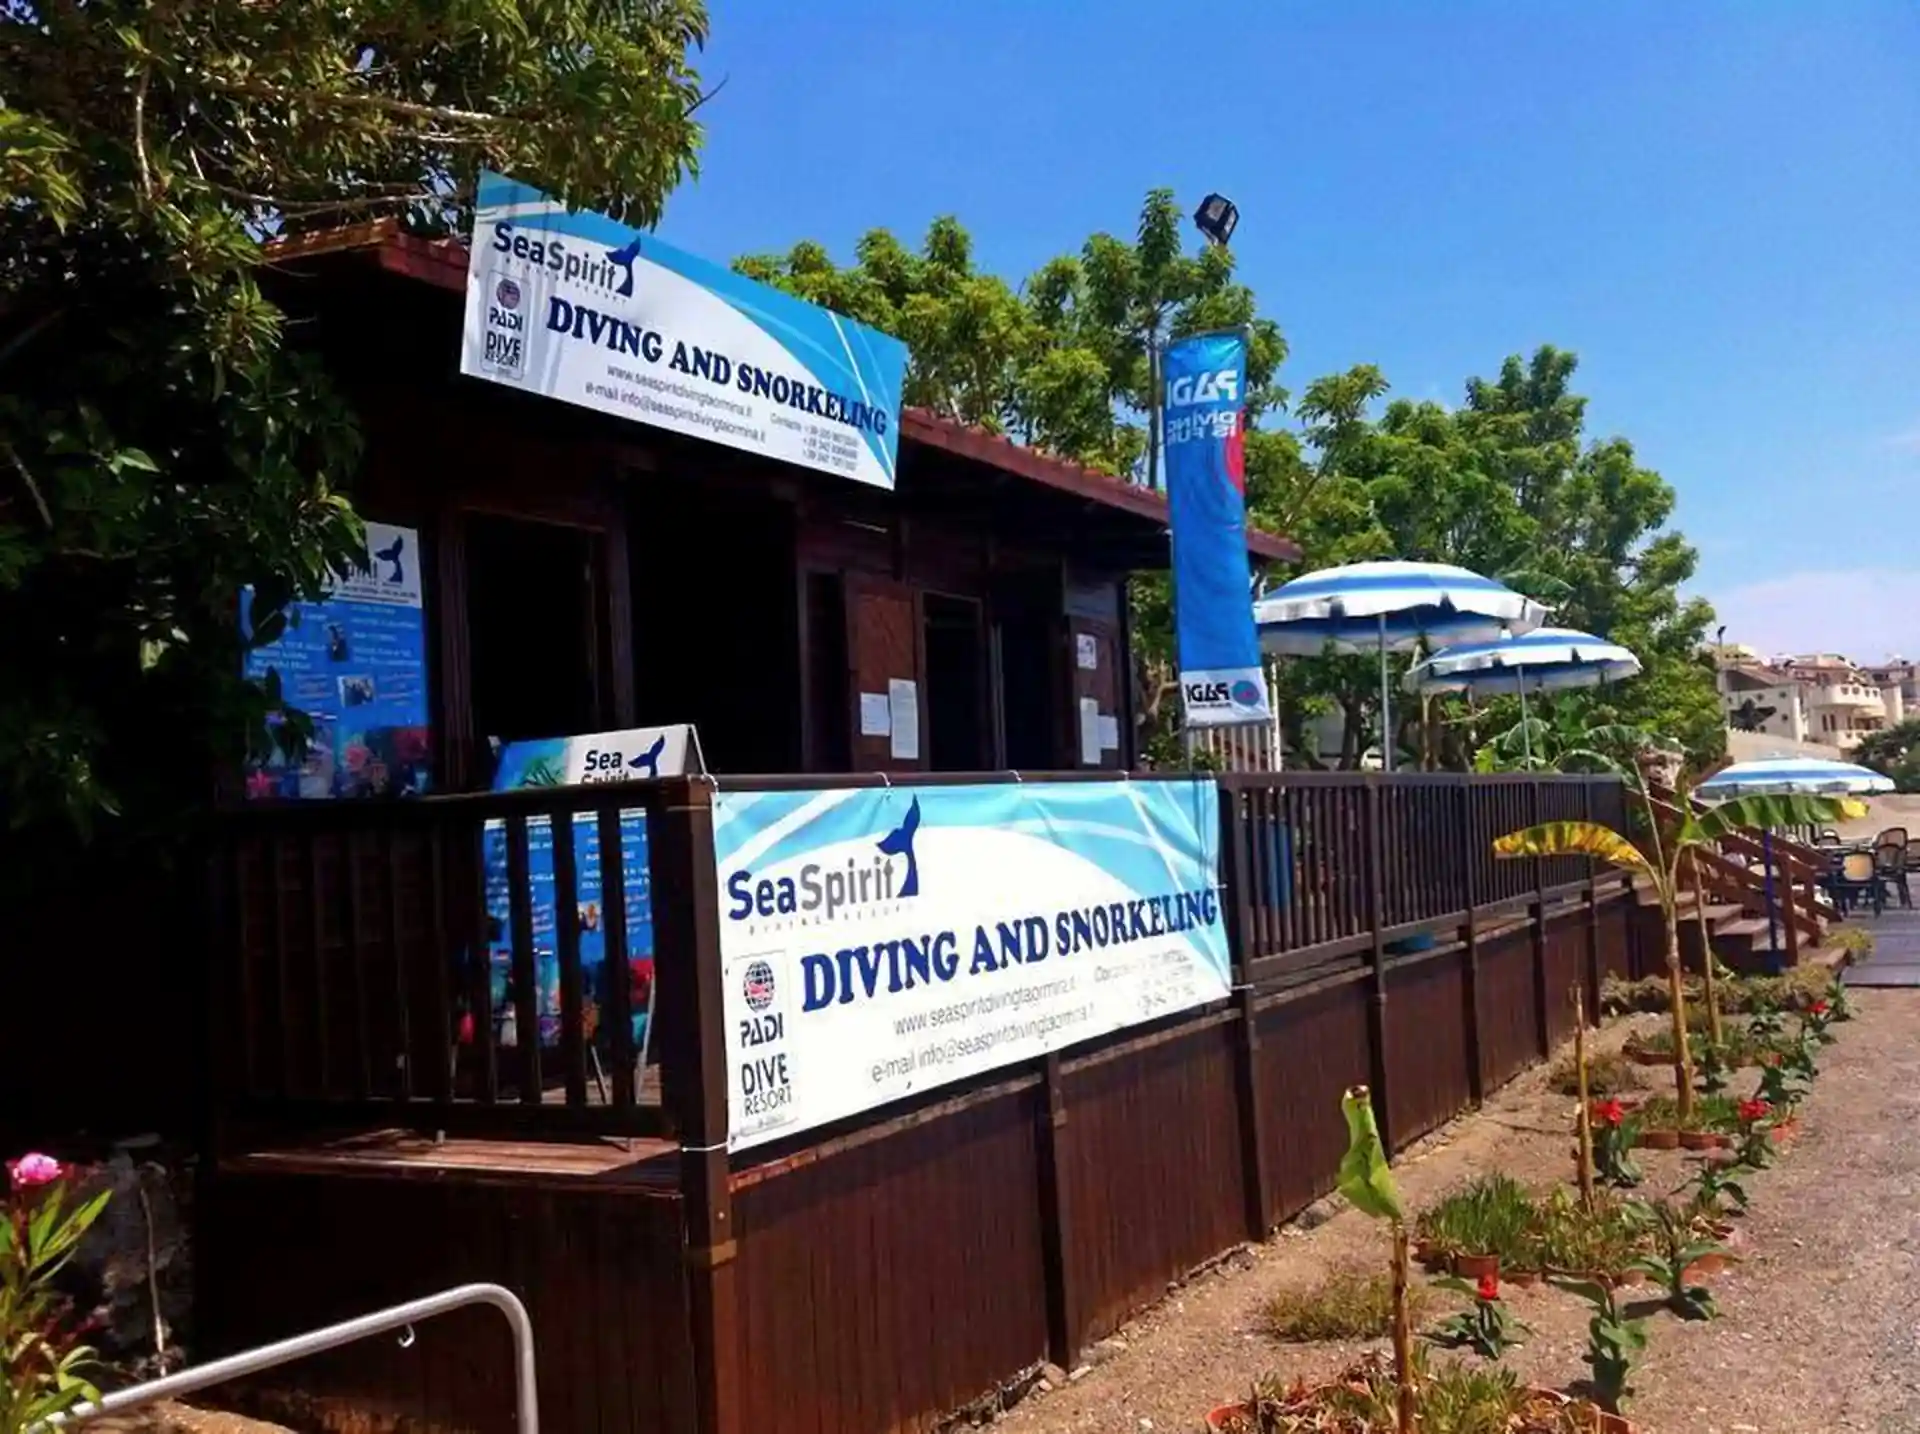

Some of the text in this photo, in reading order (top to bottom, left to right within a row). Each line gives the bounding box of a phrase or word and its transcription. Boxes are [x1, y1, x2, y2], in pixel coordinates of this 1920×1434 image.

[489, 306, 523, 331] PADI
[486, 330, 521, 357] DIVE
[547, 295, 663, 363] DIVING
[668, 340, 731, 385] AND
[737, 363, 887, 435] SNORKELING
[584, 749, 623, 771] Sea
[800, 931, 960, 1012] DIVING
[969, 916, 1049, 975] AND
[1056, 888, 1217, 956] SNORKELING
[740, 1012, 784, 1048] PADI
[741, 1053, 789, 1095] DIVE
[872, 1050, 916, 1082] e-mail
[745, 1085, 792, 1117] RESORT
